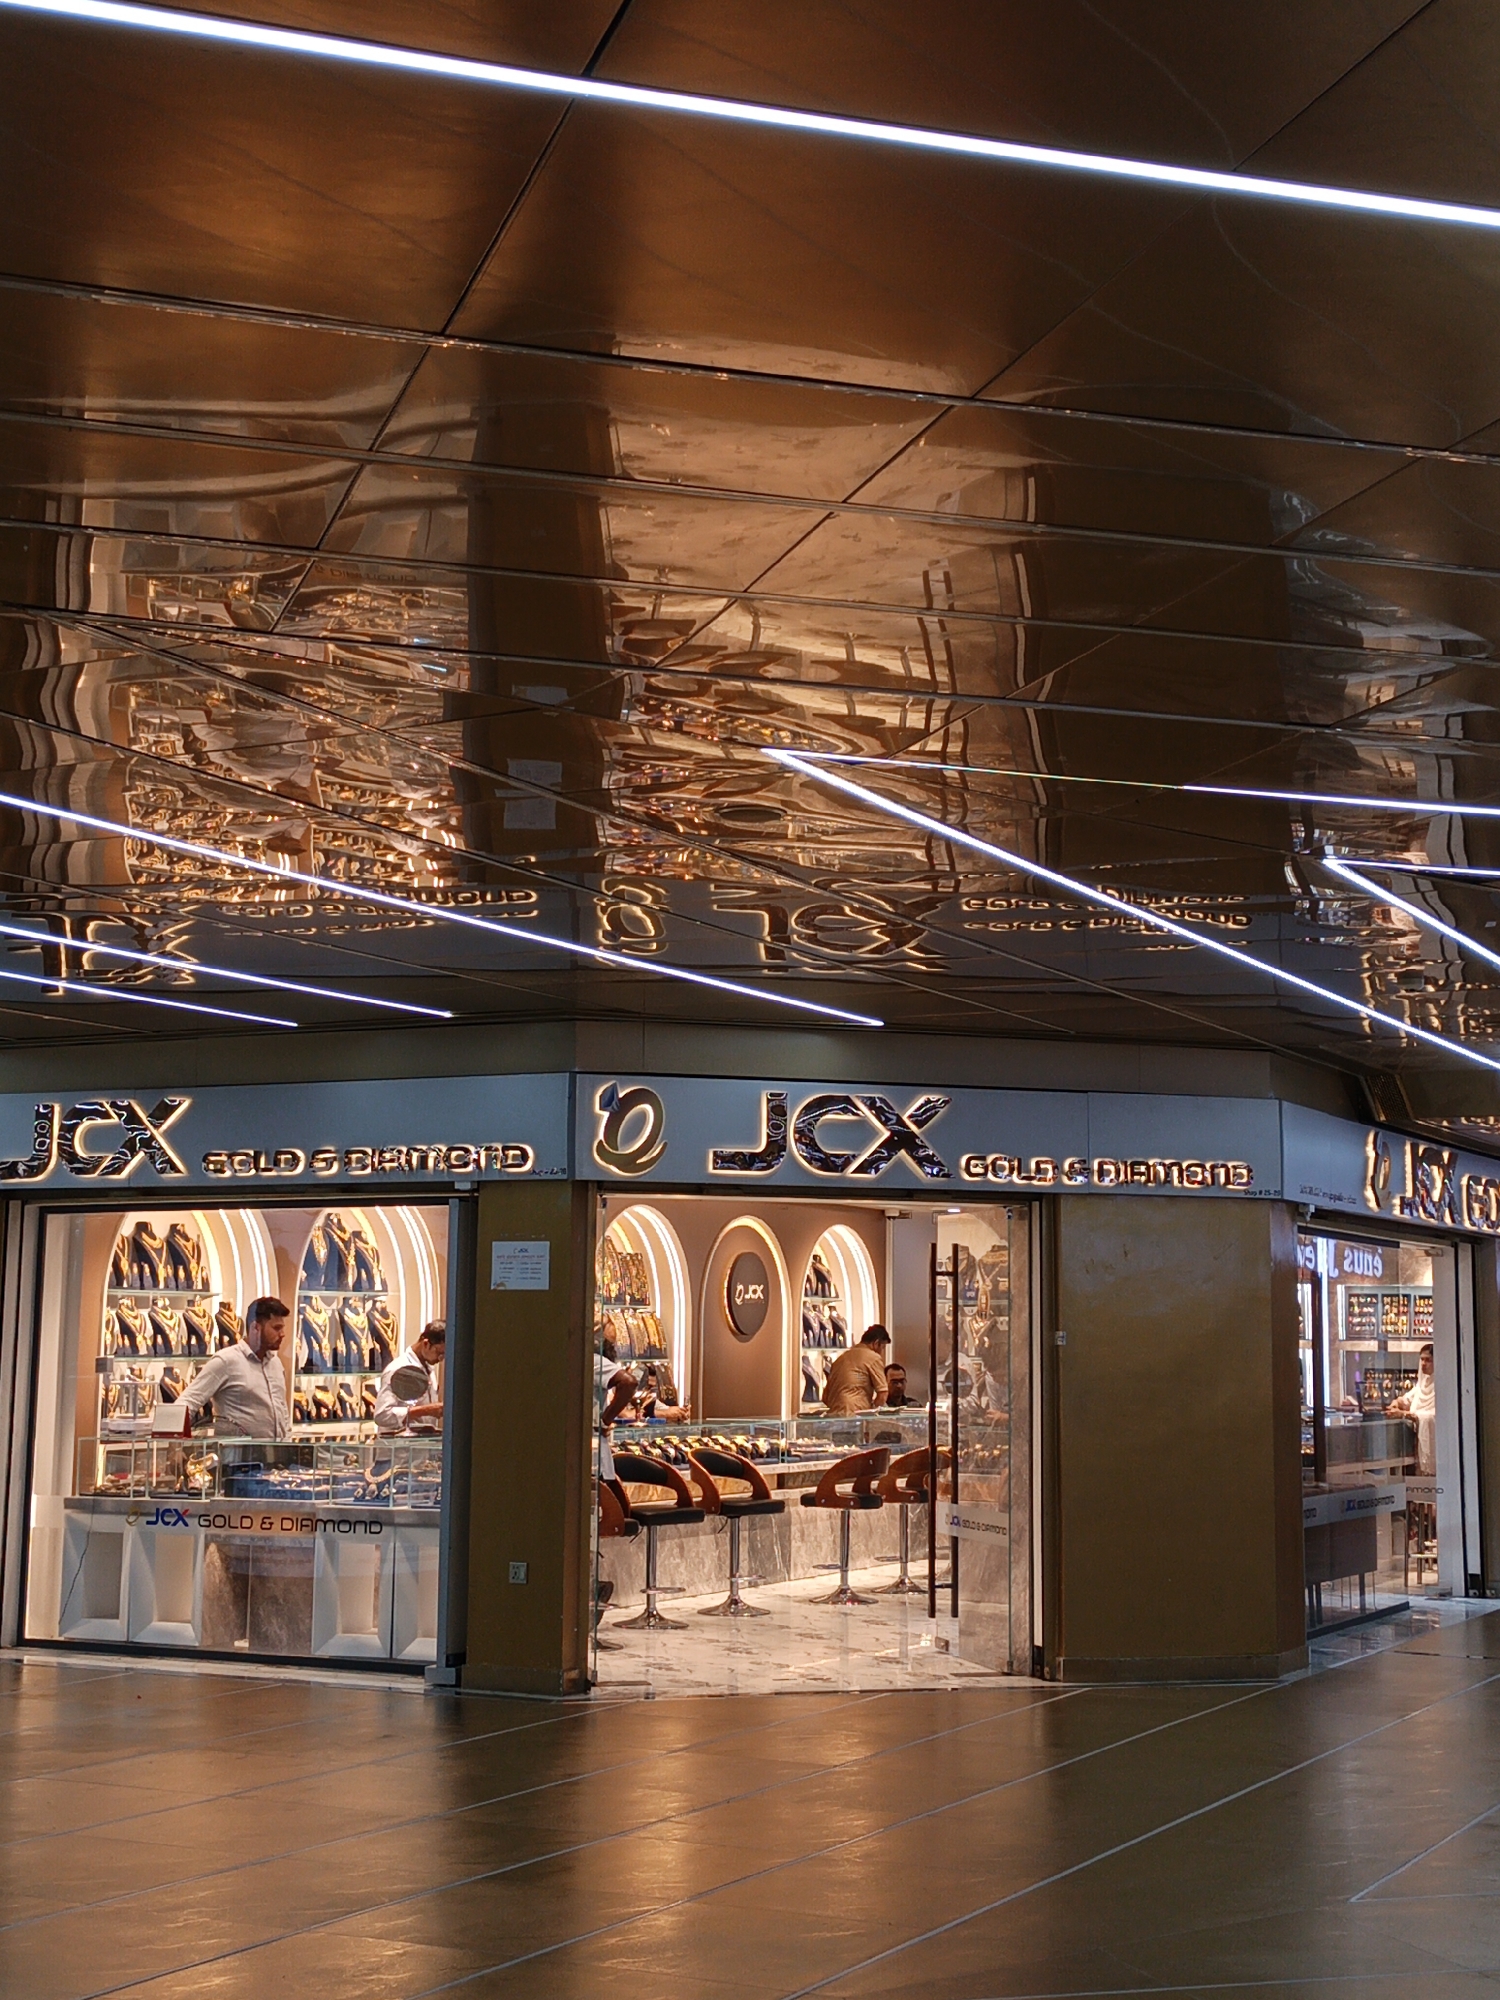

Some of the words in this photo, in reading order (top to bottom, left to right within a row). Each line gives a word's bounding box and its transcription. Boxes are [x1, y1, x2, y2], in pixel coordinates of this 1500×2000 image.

[0, 1096, 192, 1183] JCX
[201, 1148, 306, 1178] GOLD
[344, 1142, 534, 1176] DIAMOND
[707, 1090, 957, 1180] JCX
[960, 1153, 1060, 1186] GOLD
[1062, 1157, 1091, 1186] &
[1093, 1157, 1254, 1190] DIAMOND
[1461, 1174, 1500, 1233] GO
[146, 1508, 190, 1527] JCX
[198, 1514, 254, 1530] GOLD
[260, 1516, 274, 1531] &
[280, 1517, 383, 1535] DIAMOND
